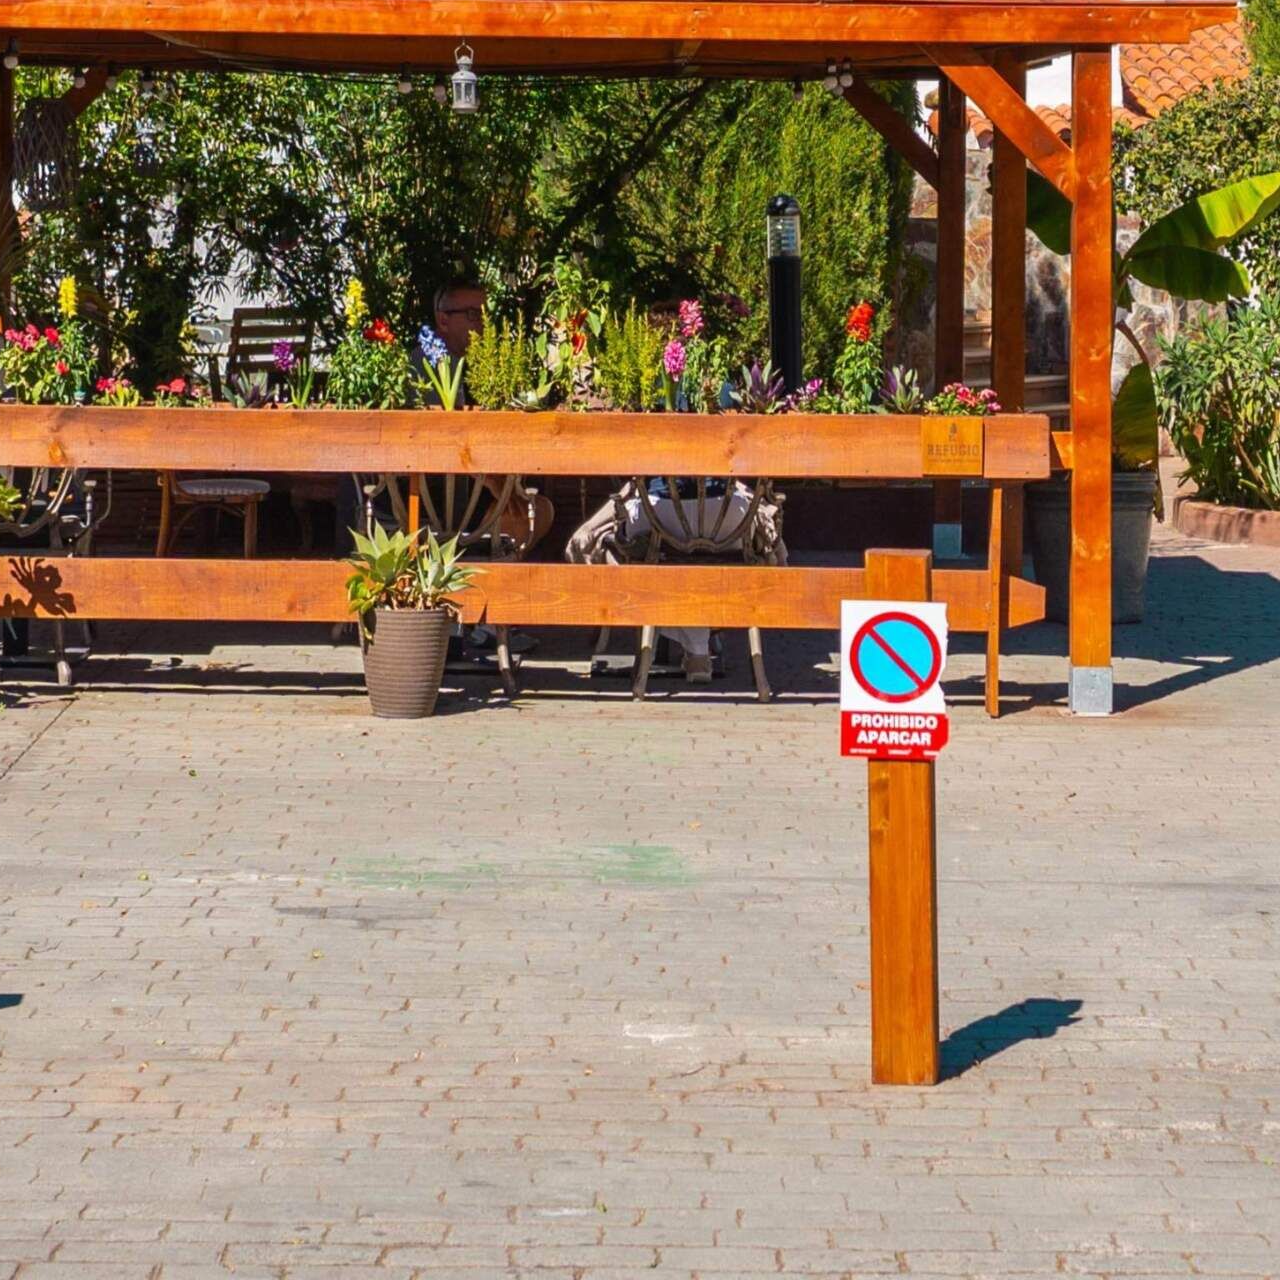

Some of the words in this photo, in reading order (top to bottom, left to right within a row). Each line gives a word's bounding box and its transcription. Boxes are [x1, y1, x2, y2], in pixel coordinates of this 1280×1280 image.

[927, 444, 980, 456] REFUGIO
[850, 713, 938, 730] PROHIBIDO
[856, 730, 932, 746] APARCAR
